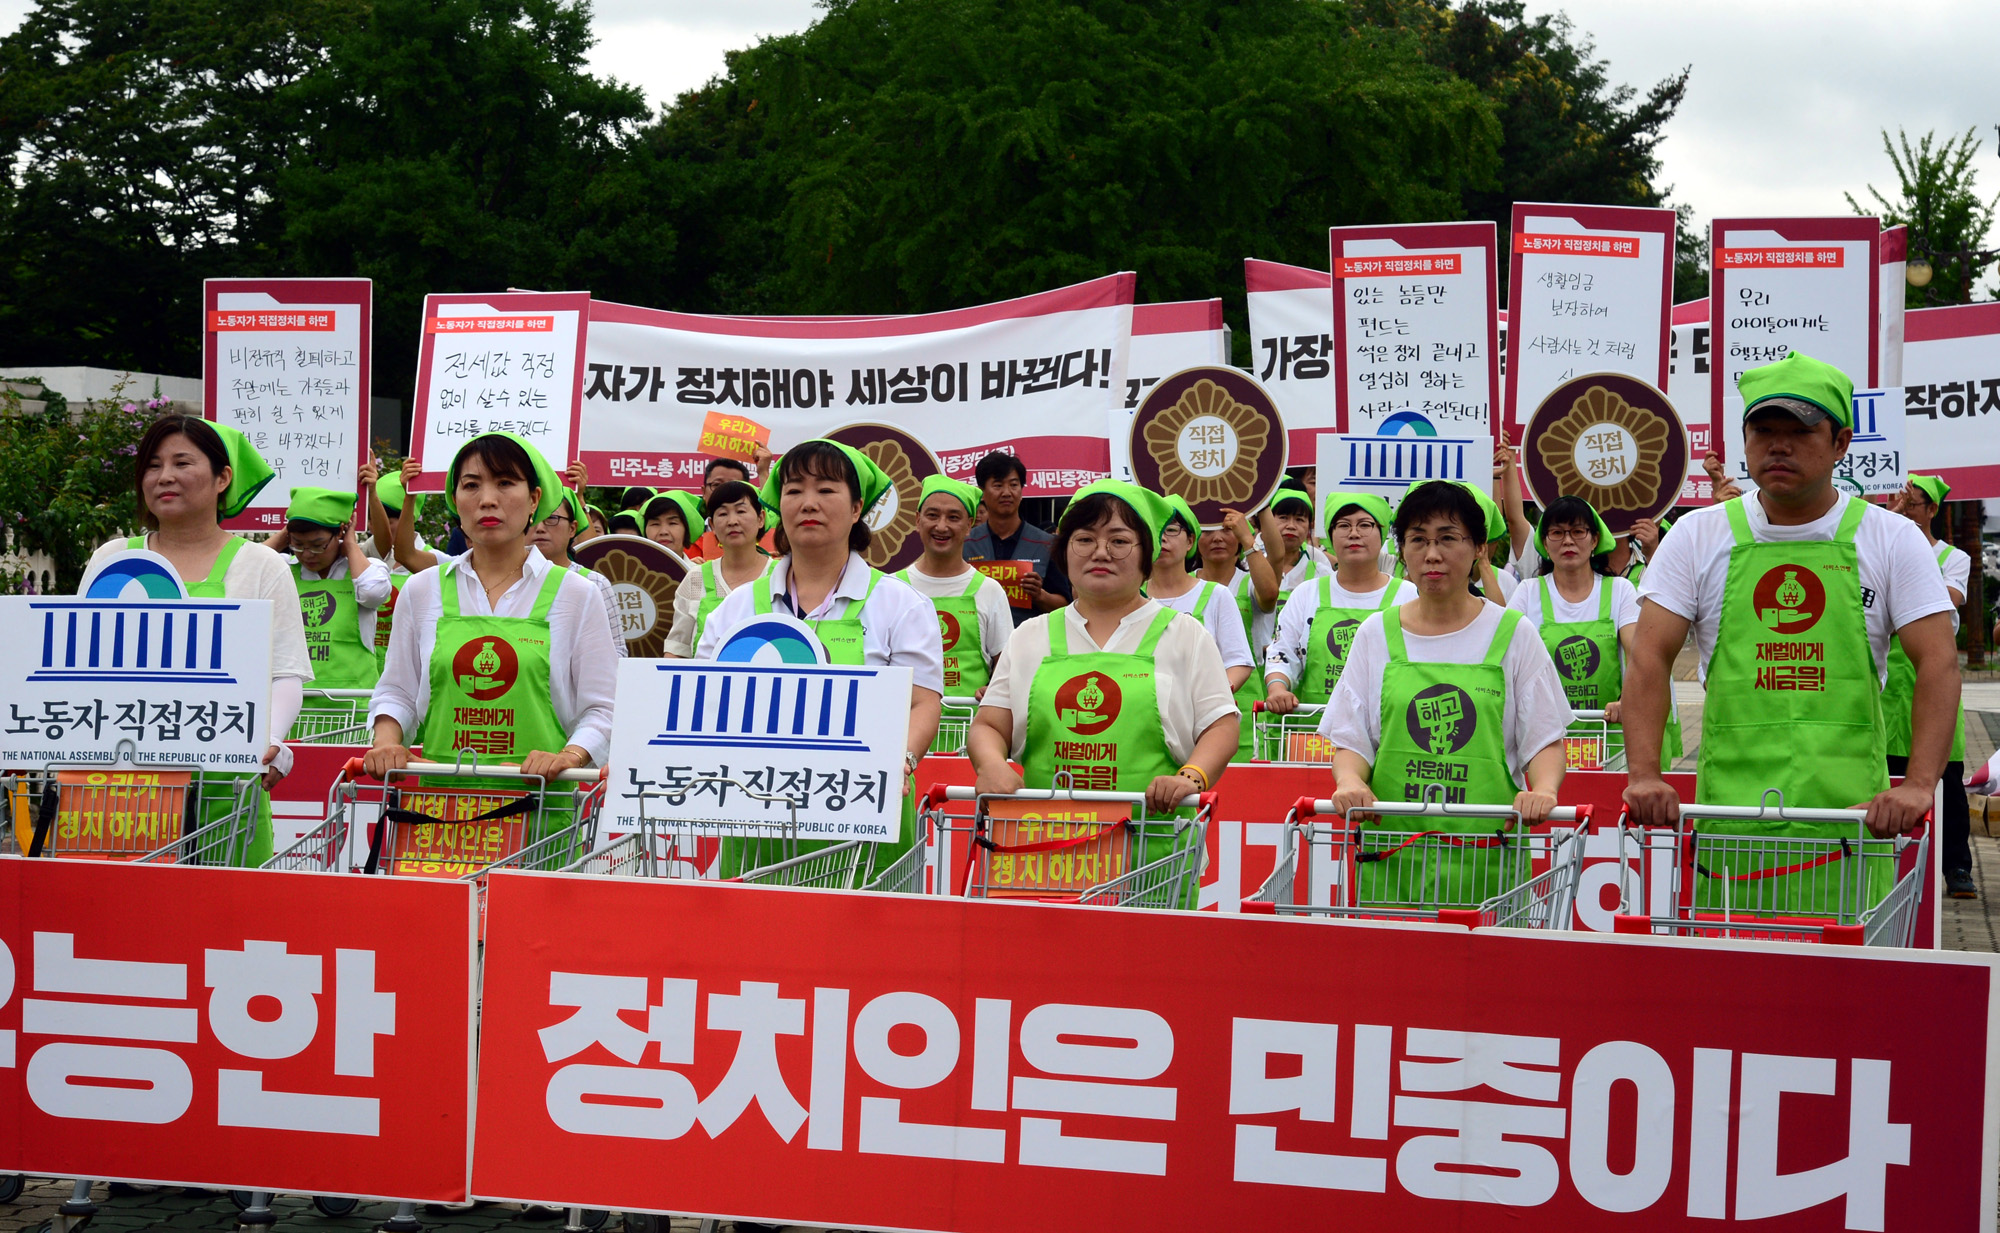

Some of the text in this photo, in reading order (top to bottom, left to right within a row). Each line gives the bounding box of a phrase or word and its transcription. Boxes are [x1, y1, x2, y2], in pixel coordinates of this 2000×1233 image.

[1523, 238, 1632, 253] 노동자가 직접정치를 하면
[1344, 258, 1454, 273] 노동자가 직접정치를 하면
[1724, 252, 1836, 264] 노동자가 직접정치를 하면
[1354, 285, 1448, 305] 있는 놈들만
[1740, 288, 1770, 307] 우리
[1552, 299, 1608, 317] 보장하여
[217, 315, 328, 326] 노동자가 직접정치를 하면
[436, 319, 546, 330] 노동자가 직접정치를 하면
[1358, 318, 1410, 338] 편드는
[1731, 314, 1829, 334] 아이들에게는
[230, 347, 286, 371] 비정규직
[1357, 342, 1480, 364] 썩은 정치 끝내고
[1730, 342, 1788, 361] 헬조선을
[444, 350, 554, 379] 전세값 걱정
[298, 377, 350, 396] 가족들과
[584, 363, 665, 402] 자가
[676, 367, 834, 408] 정치해야
[846, 362, 968, 406] 세상이
[1359, 370, 1465, 390] 열심히 일하는
[440, 388, 466, 410] 없이
[518, 388, 548, 408] 있는
[293, 404, 304, 422] 수
[436, 420, 482, 438] 나라를
[718, 418, 757, 437] 우리가
[1188, 424, 1225, 444] 직접
[1584, 430, 1624, 452] 직접
[610, 458, 674, 478] 민주노총
[1190, 448, 1226, 469] 정치
[1588, 455, 1627, 478] 정치
[1835, 450, 1900, 478] 접정치
[1682, 480, 1713, 499] 홈플
[1841, 484, 1873, 492] REPULIC
[262, 514, 281, 525] 마트
[978, 566, 1018, 581] 우리가
[302, 596, 326, 608] 해고
[305, 632, 330, 642] 운해고
[308, 645, 330, 661] 대!
[480, 652, 494, 660] TAX
[1562, 642, 1590, 660] 해고
[1756, 642, 1824, 662] 재벌에게
[944, 671, 960, 686] 을!
[1326, 664, 1345, 676] 쉬운
[1754, 666, 1825, 692] 세금을!
[453, 707, 514, 728] 재벌에게
[1420, 696, 1460, 722] 해고
[4, 698, 256, 744] 노동자 직접정치
[452, 730, 515, 754] 세금을!
[1054, 741, 1116, 762] 재벌에게
[1566, 742, 1598, 761] 능한
[2, 751, 18, 762] THE
[20, 751, 66, 762] NATIONAL
[138, 752, 156, 762] THE
[158, 752, 206, 763] REPUBLIC
[208, 753, 222, 764] OF
[224, 754, 258, 764] KOREA
[1406, 760, 1468, 782] 쉬운해고
[84, 773, 160, 800] 우리가
[621, 763, 888, 814] 노동자 직접정치
[616, 816, 635, 826] THE
[784, 822, 834, 832] RPUBLIC
[838, 824, 850, 834] OF
[854, 824, 887, 834] KOREA
[1018, 812, 1098, 842] 우리가
[414, 823, 504, 852] 정치인은
[0, 932, 1912, 1233] 능한 정치인은 민중이다
